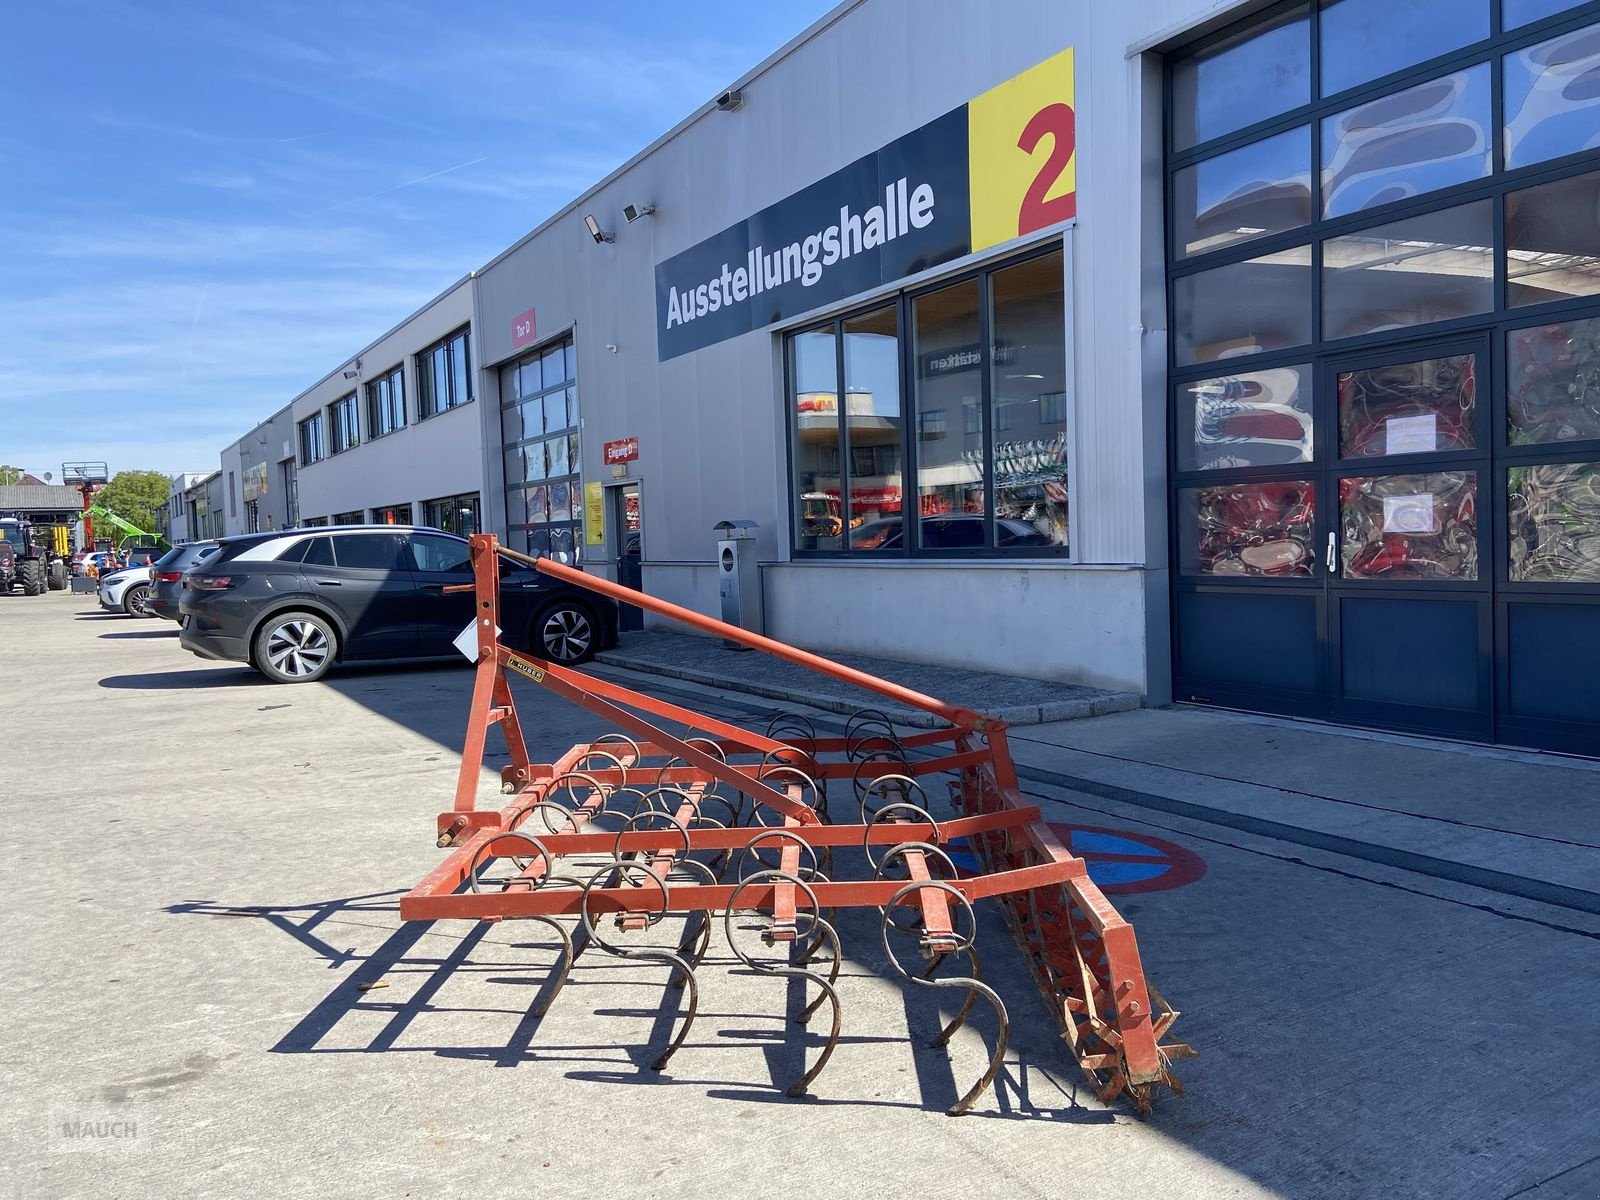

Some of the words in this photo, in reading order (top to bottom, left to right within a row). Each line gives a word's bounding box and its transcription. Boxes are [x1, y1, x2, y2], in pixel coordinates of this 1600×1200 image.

[666, 177, 935, 329] Ausstellungshalle
[1017, 102, 1076, 236] 2
[516, 324, 525, 338] Tor
[525, 320, 530, 334] D
[608, 447, 627, 459] Eingang
[628, 444, 633, 454] D
[517, 663, 542, 678] HUBER
